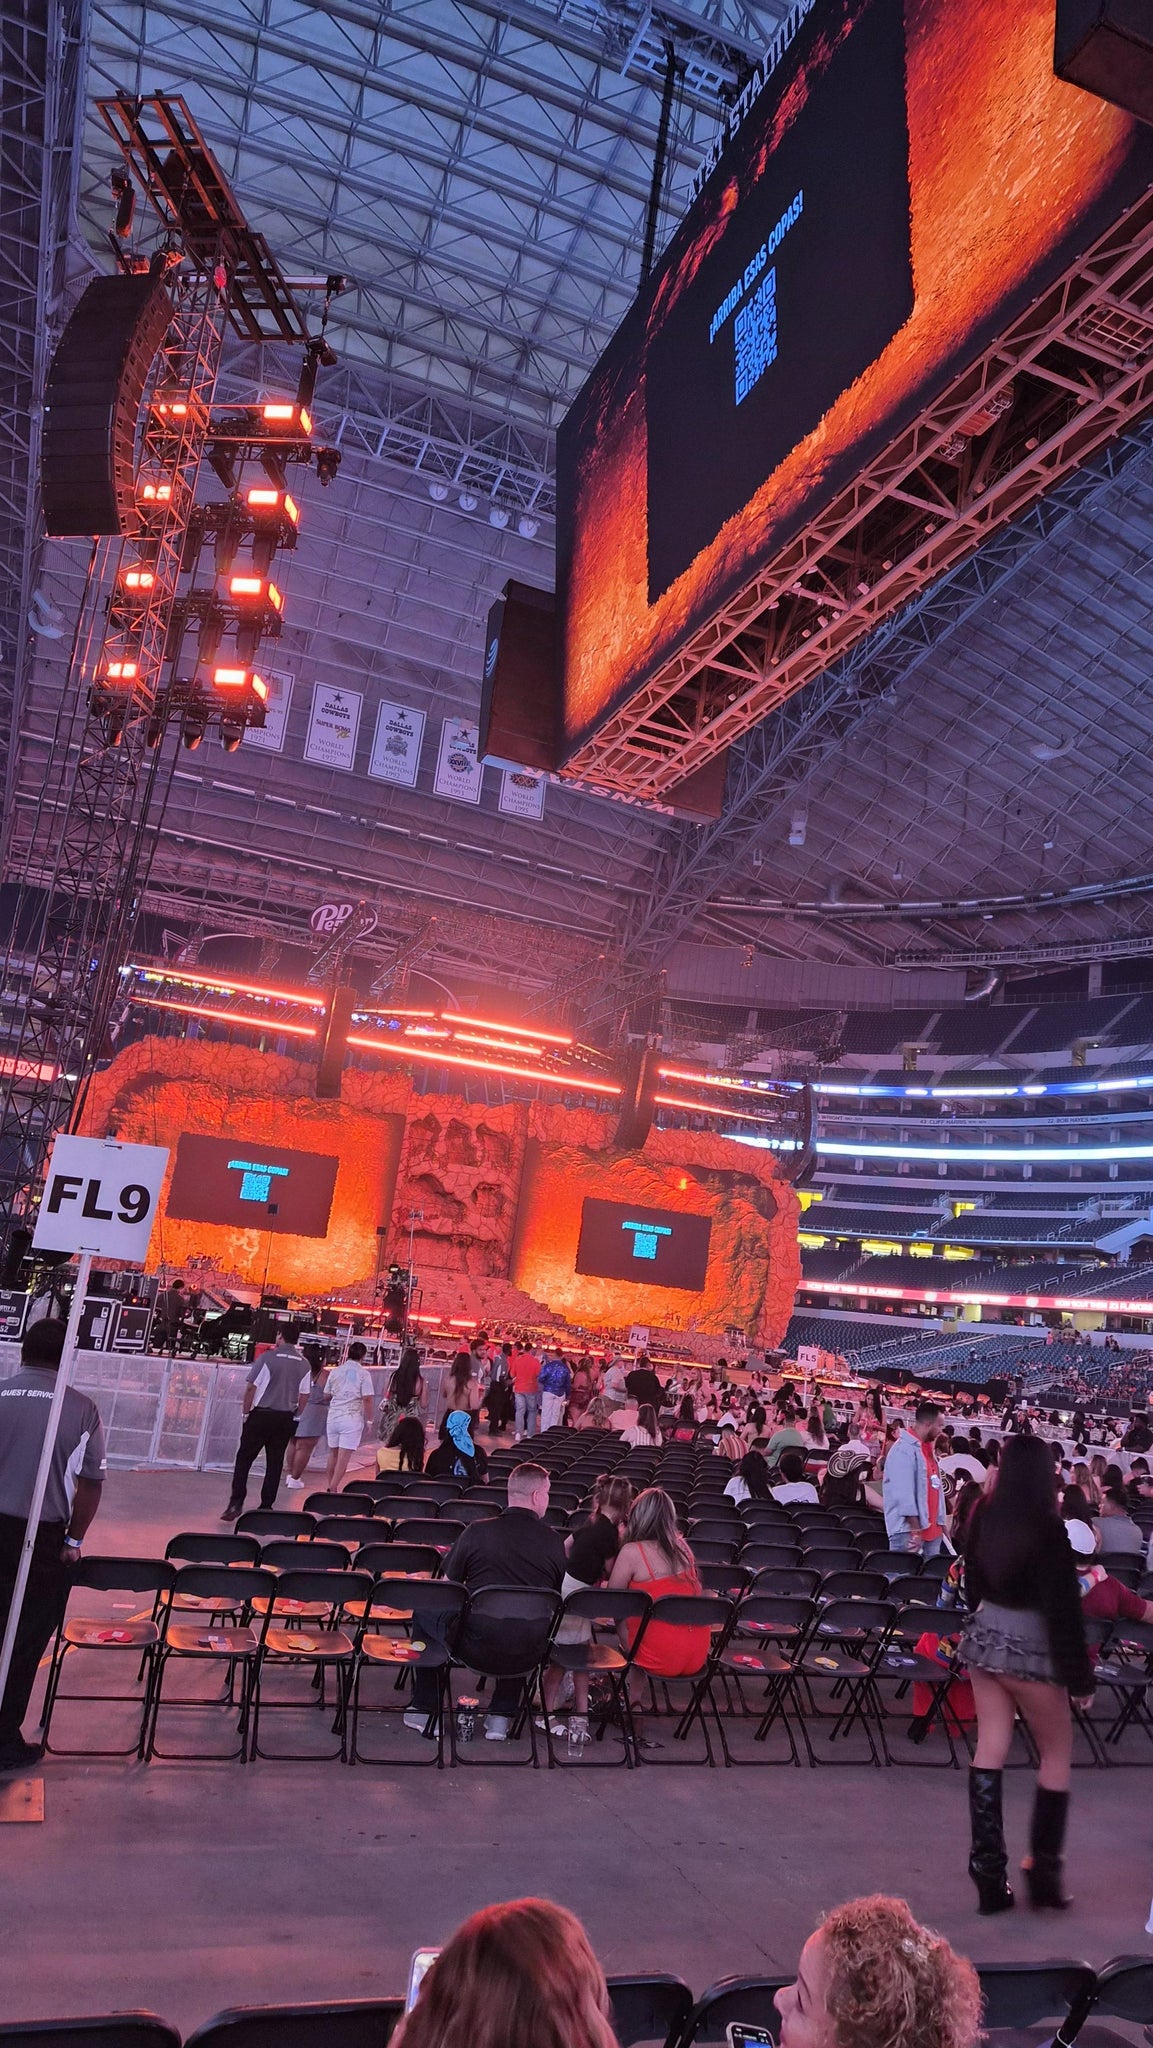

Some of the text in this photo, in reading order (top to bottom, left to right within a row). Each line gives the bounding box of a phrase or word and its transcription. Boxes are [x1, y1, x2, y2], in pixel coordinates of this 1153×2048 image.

[709, 189, 804, 344] ¡ARRIBA ESAS COPAS!
[320, 707, 351, 720] COWBOYS
[324, 702, 349, 713] DALLAS
[315, 718, 333, 729] SUPER
[388, 720, 413, 731] DALLAS
[246, 727, 280, 740] AMPIONS
[385, 725, 414, 737] COWBOYS
[250, 733, 265, 743] 1971
[318, 738, 344, 750] WORLD
[309, 743, 351, 759] CHAMPIONS
[383, 755, 407, 767] WORLD
[374, 760, 413, 776] CHAMPIONS
[385, 770, 401, 779] 1992
[447, 773, 471, 784] WORLD
[439, 777, 477, 793] CHAMPIONS
[522, 766, 675, 816] WNSTAR
[511, 790, 535, 801] WORLD
[503, 795, 541, 810] CHAMPIONS
[47, 1174, 151, 1224] FL9
[631, 1332, 647, 1342] FL4
[800, 1353, 817, 1362] FL5
[1, 1389, 55, 1399] GUEST SERVIC
